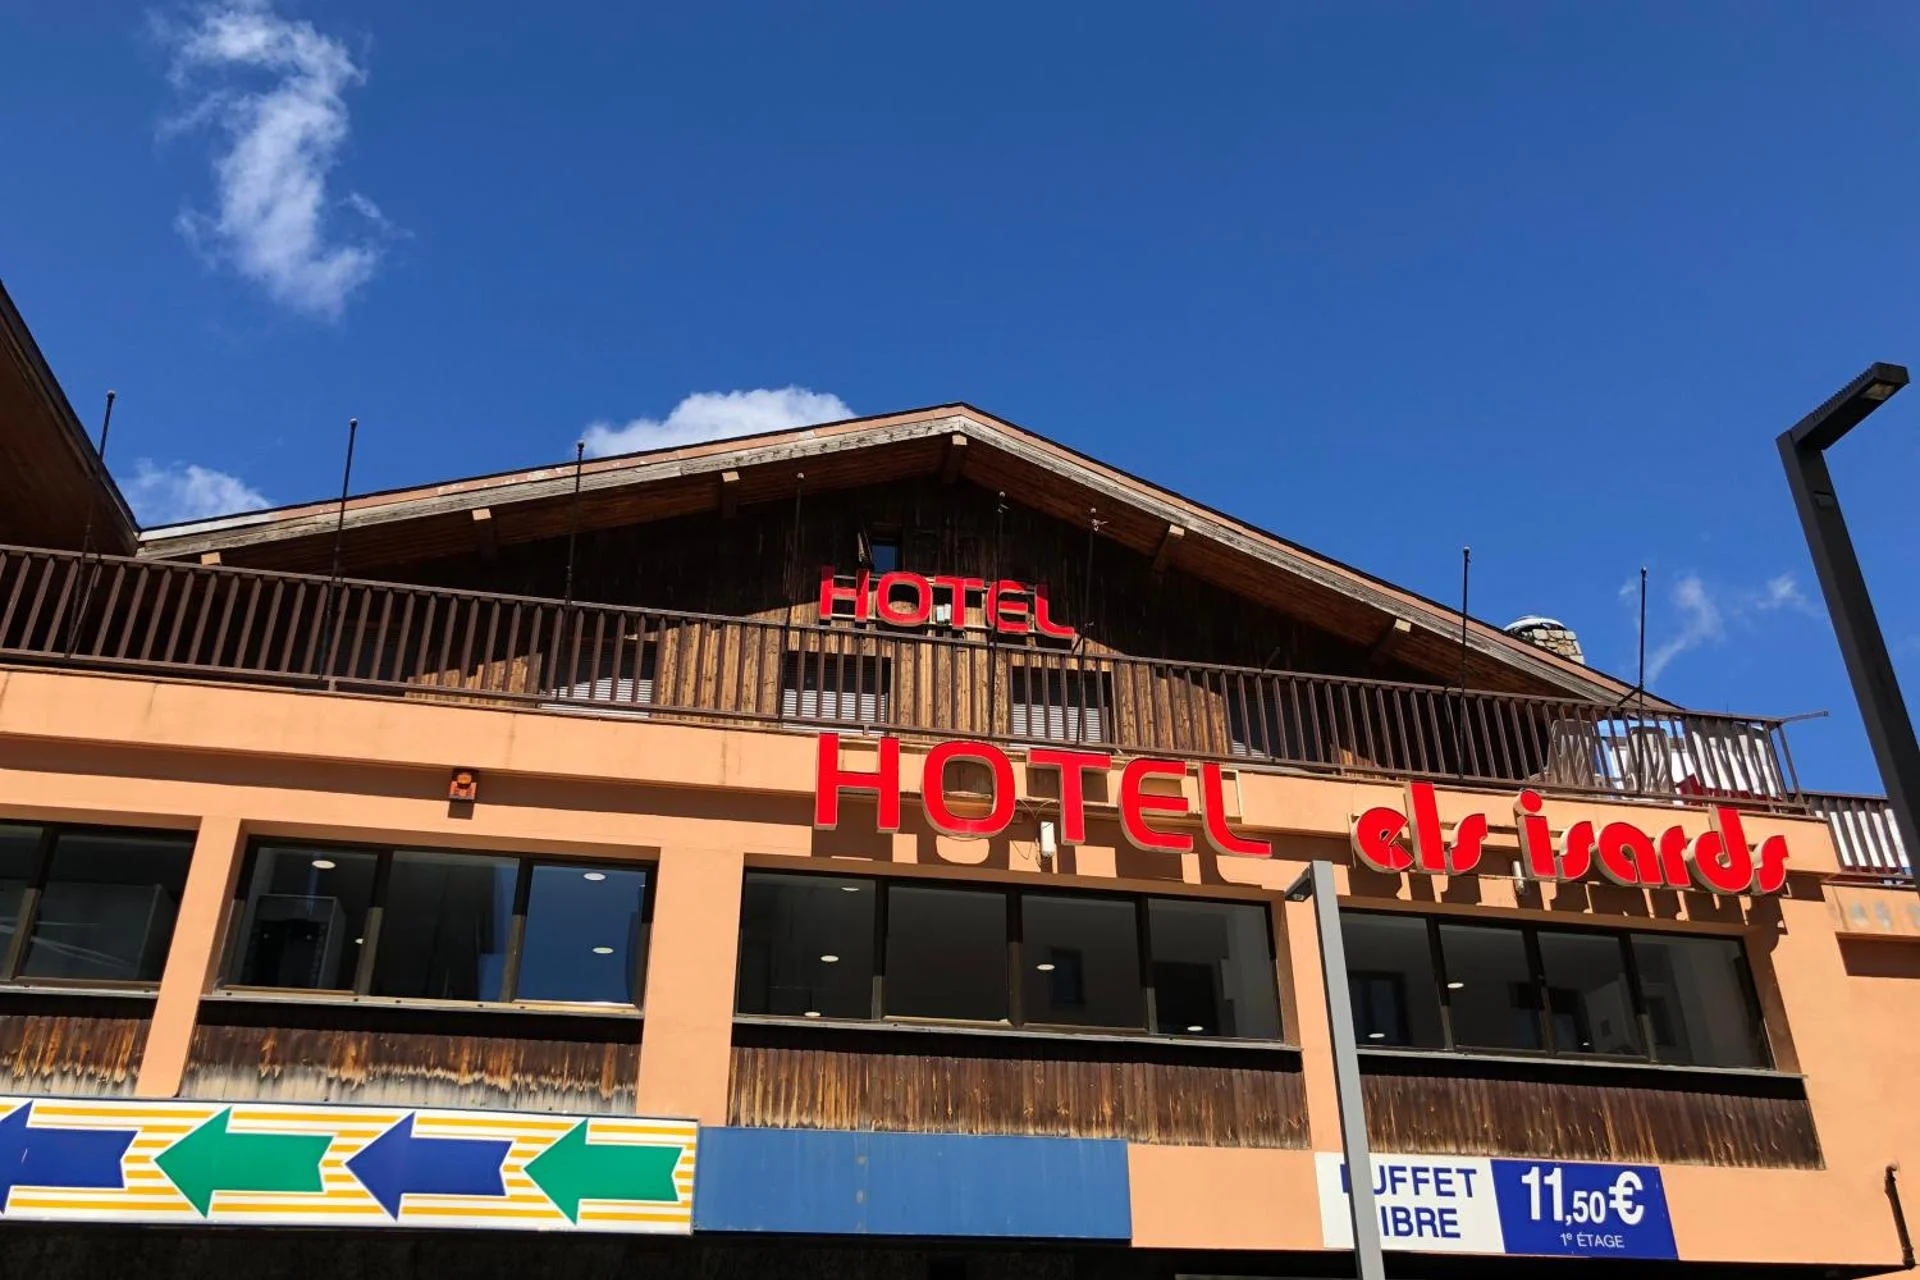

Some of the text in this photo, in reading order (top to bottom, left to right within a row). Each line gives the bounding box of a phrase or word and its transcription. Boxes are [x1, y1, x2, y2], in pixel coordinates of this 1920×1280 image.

[819, 565, 1075, 639] HOTEL
[814, 732, 1789, 896] HOTEL els isards
[1380, 1206, 1461, 1239] IBRE
[1576, 1231, 1626, 1249] ÉTAGE
